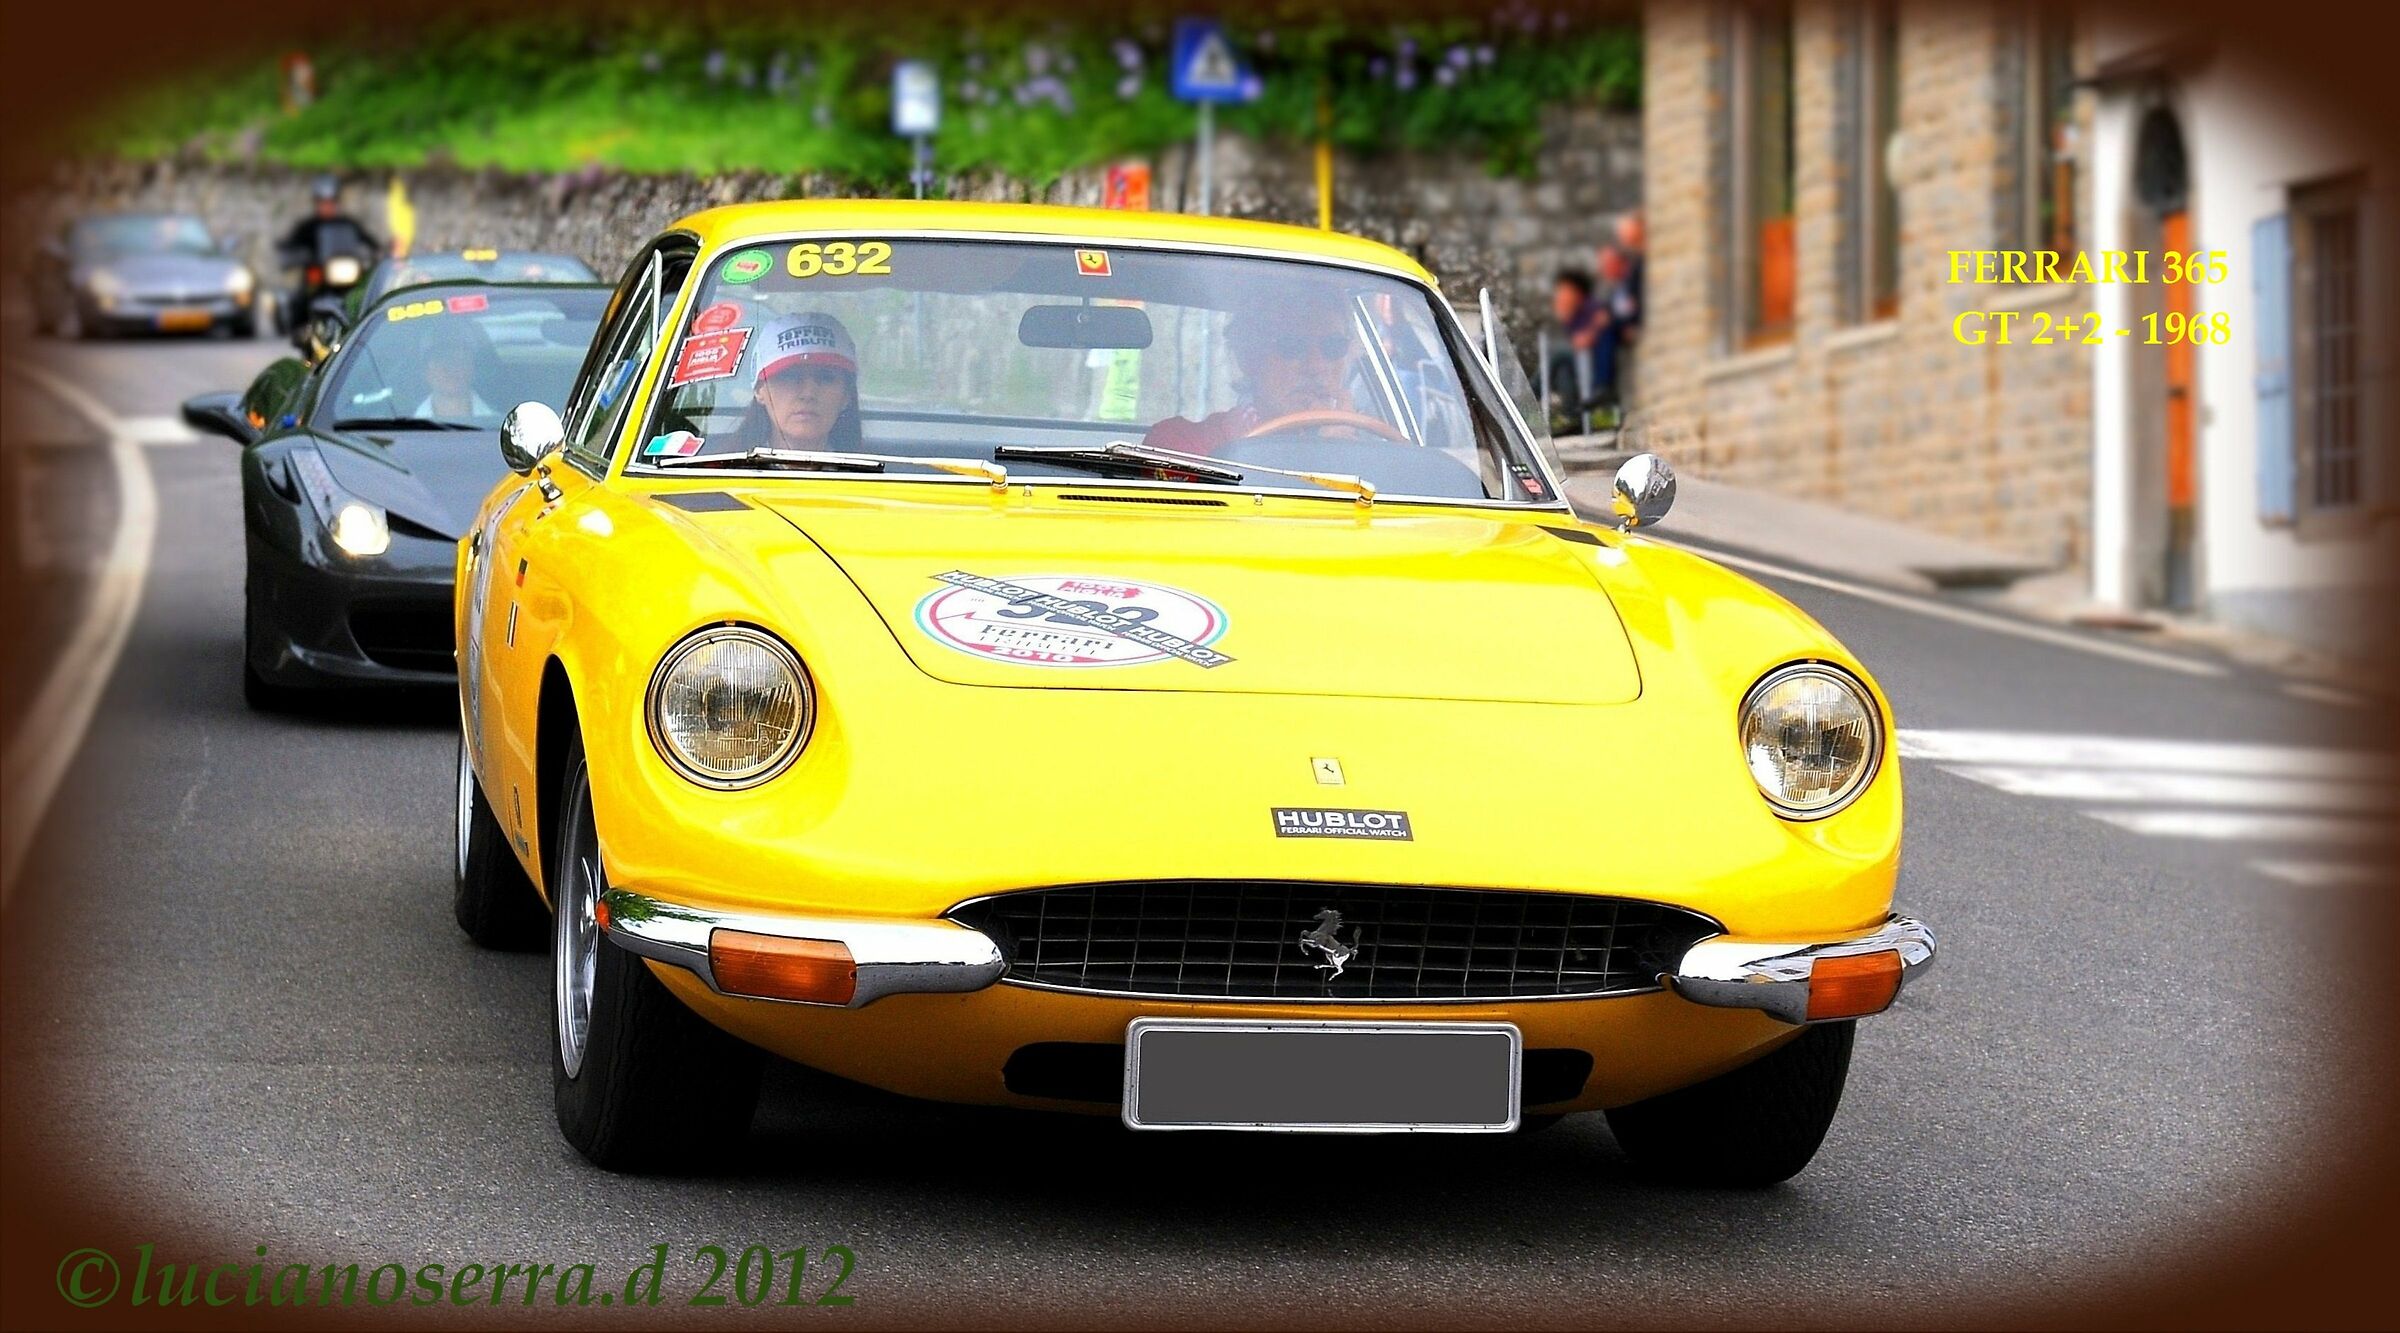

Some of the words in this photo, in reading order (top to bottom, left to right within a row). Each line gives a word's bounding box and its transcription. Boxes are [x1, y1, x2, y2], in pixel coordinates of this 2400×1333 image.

[787, 241, 892, 278] 632
[777, 337, 836, 351] TRIBUTE
[1034, 595, 1133, 627] HUBLOT
[1128, 625, 1229, 663] HUBLOT
[991, 644, 1074, 662] 2010
[1277, 810, 1403, 829] HUBLOT
[1280, 826, 1322, 835] FERRARI
[1323, 827, 1369, 836] OFFICIAL
[1368, 829, 1407, 837] WATCH
